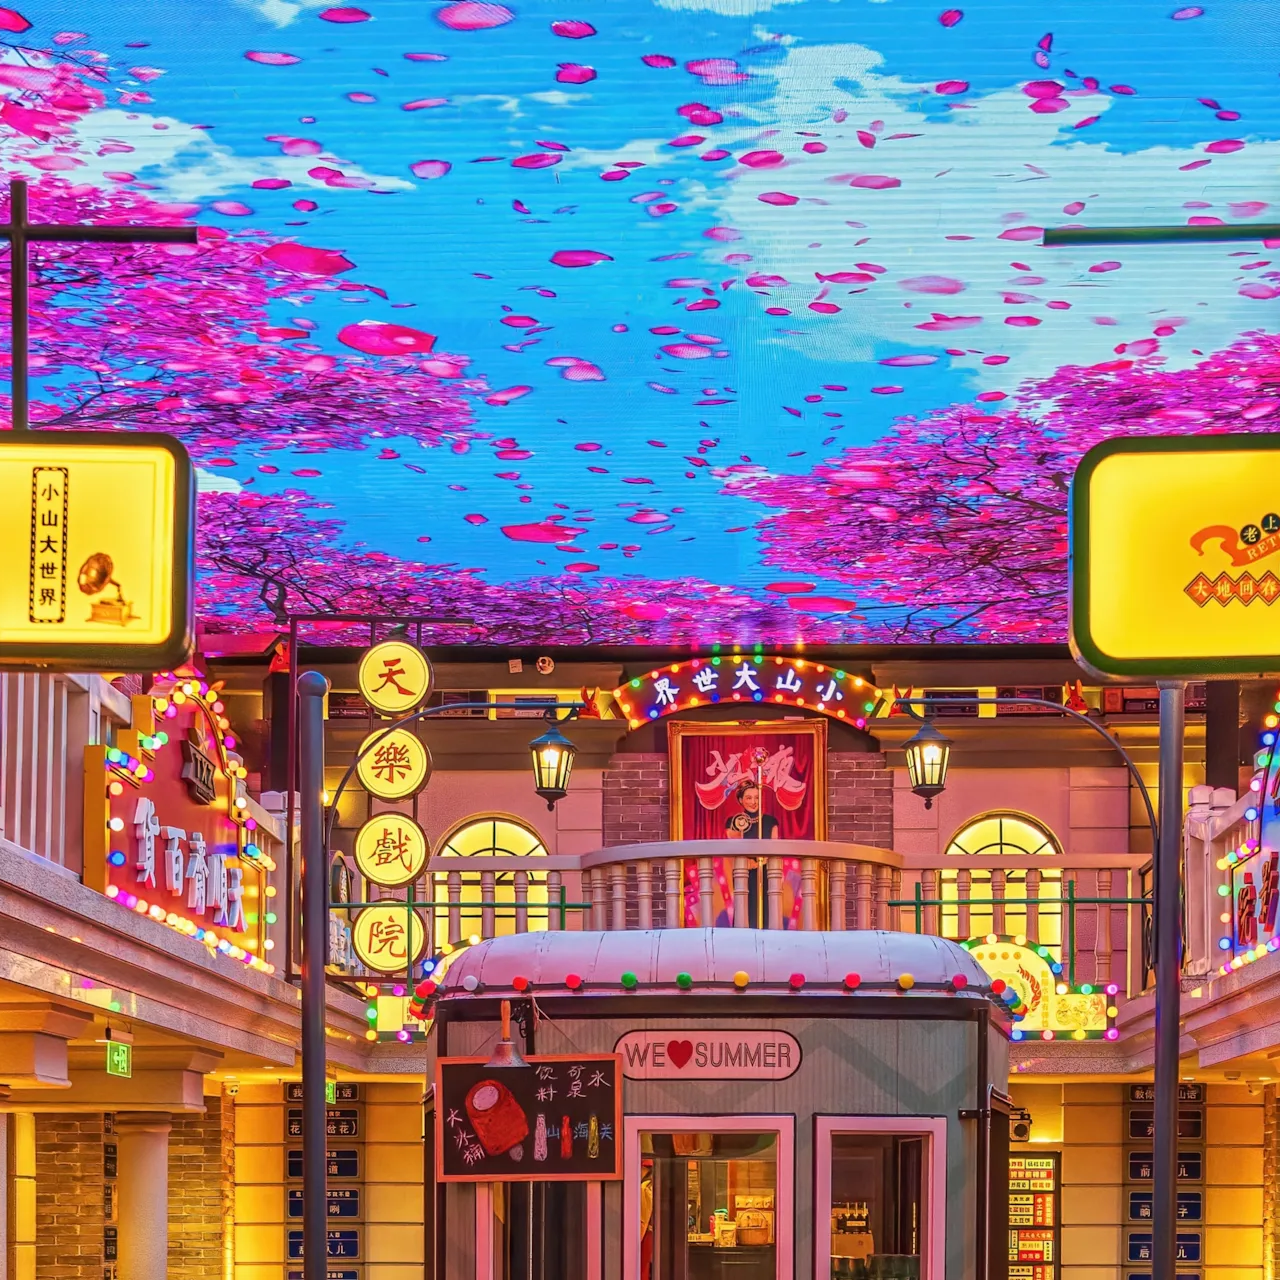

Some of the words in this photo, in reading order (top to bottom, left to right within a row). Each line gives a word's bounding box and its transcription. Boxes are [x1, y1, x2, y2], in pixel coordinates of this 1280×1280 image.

[38, 482, 61, 608] 小山大世界
[1193, 581, 1278, 597] 大地回春
[624, 1042, 666, 1068] WE
[694, 1041, 792, 1069] SUMMER
[535, 1065, 558, 1103] 饮料
